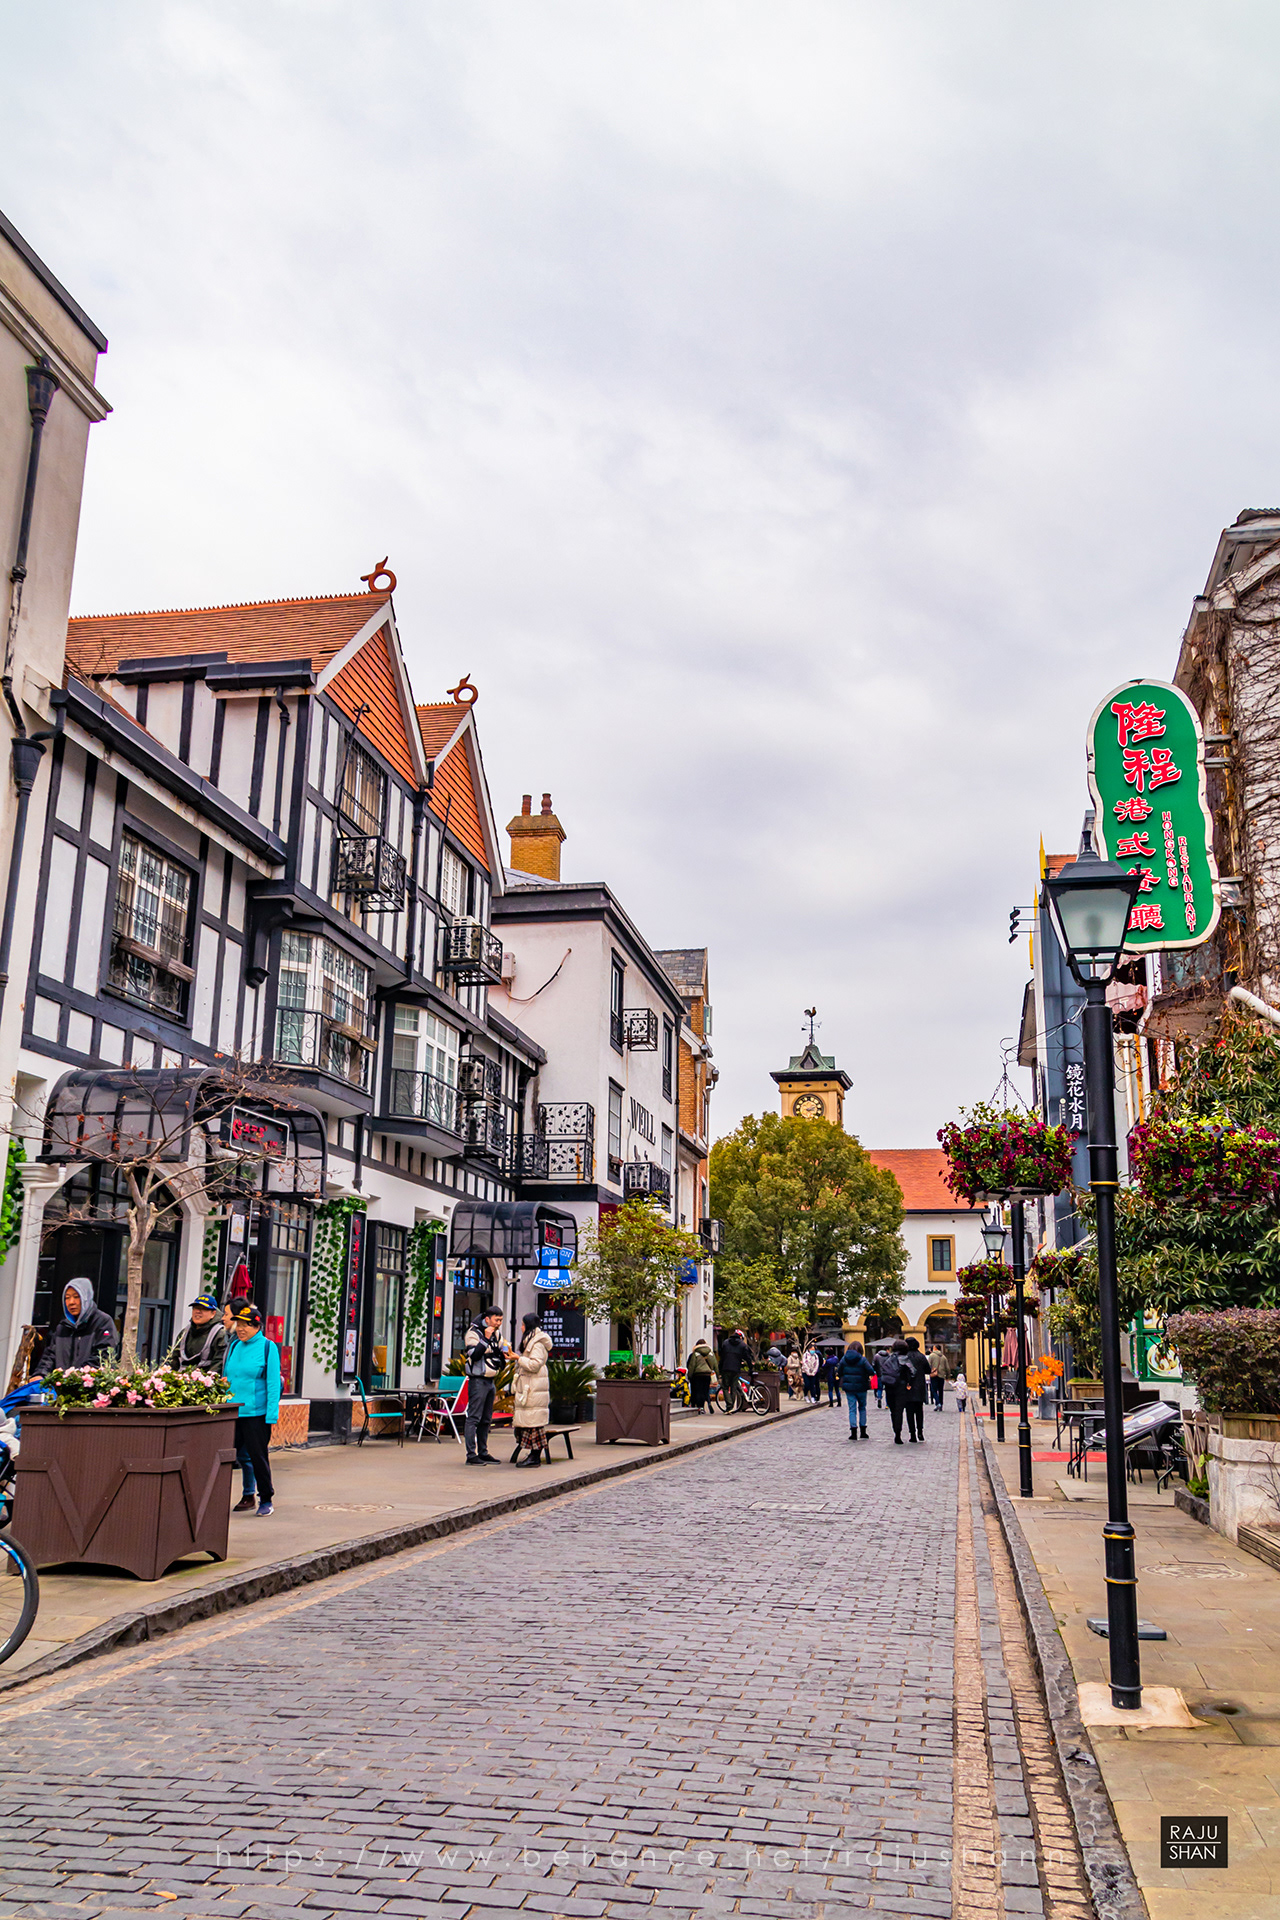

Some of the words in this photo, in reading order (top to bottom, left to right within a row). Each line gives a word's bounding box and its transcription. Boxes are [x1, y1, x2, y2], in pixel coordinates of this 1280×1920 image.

[1111, 701, 1182, 793] 隆程
[1162, 811, 1179, 888] HONGKONG
[1177, 836, 1197, 933] RESTAURANT
[1066, 1064, 1085, 1130] 鏡花水月
